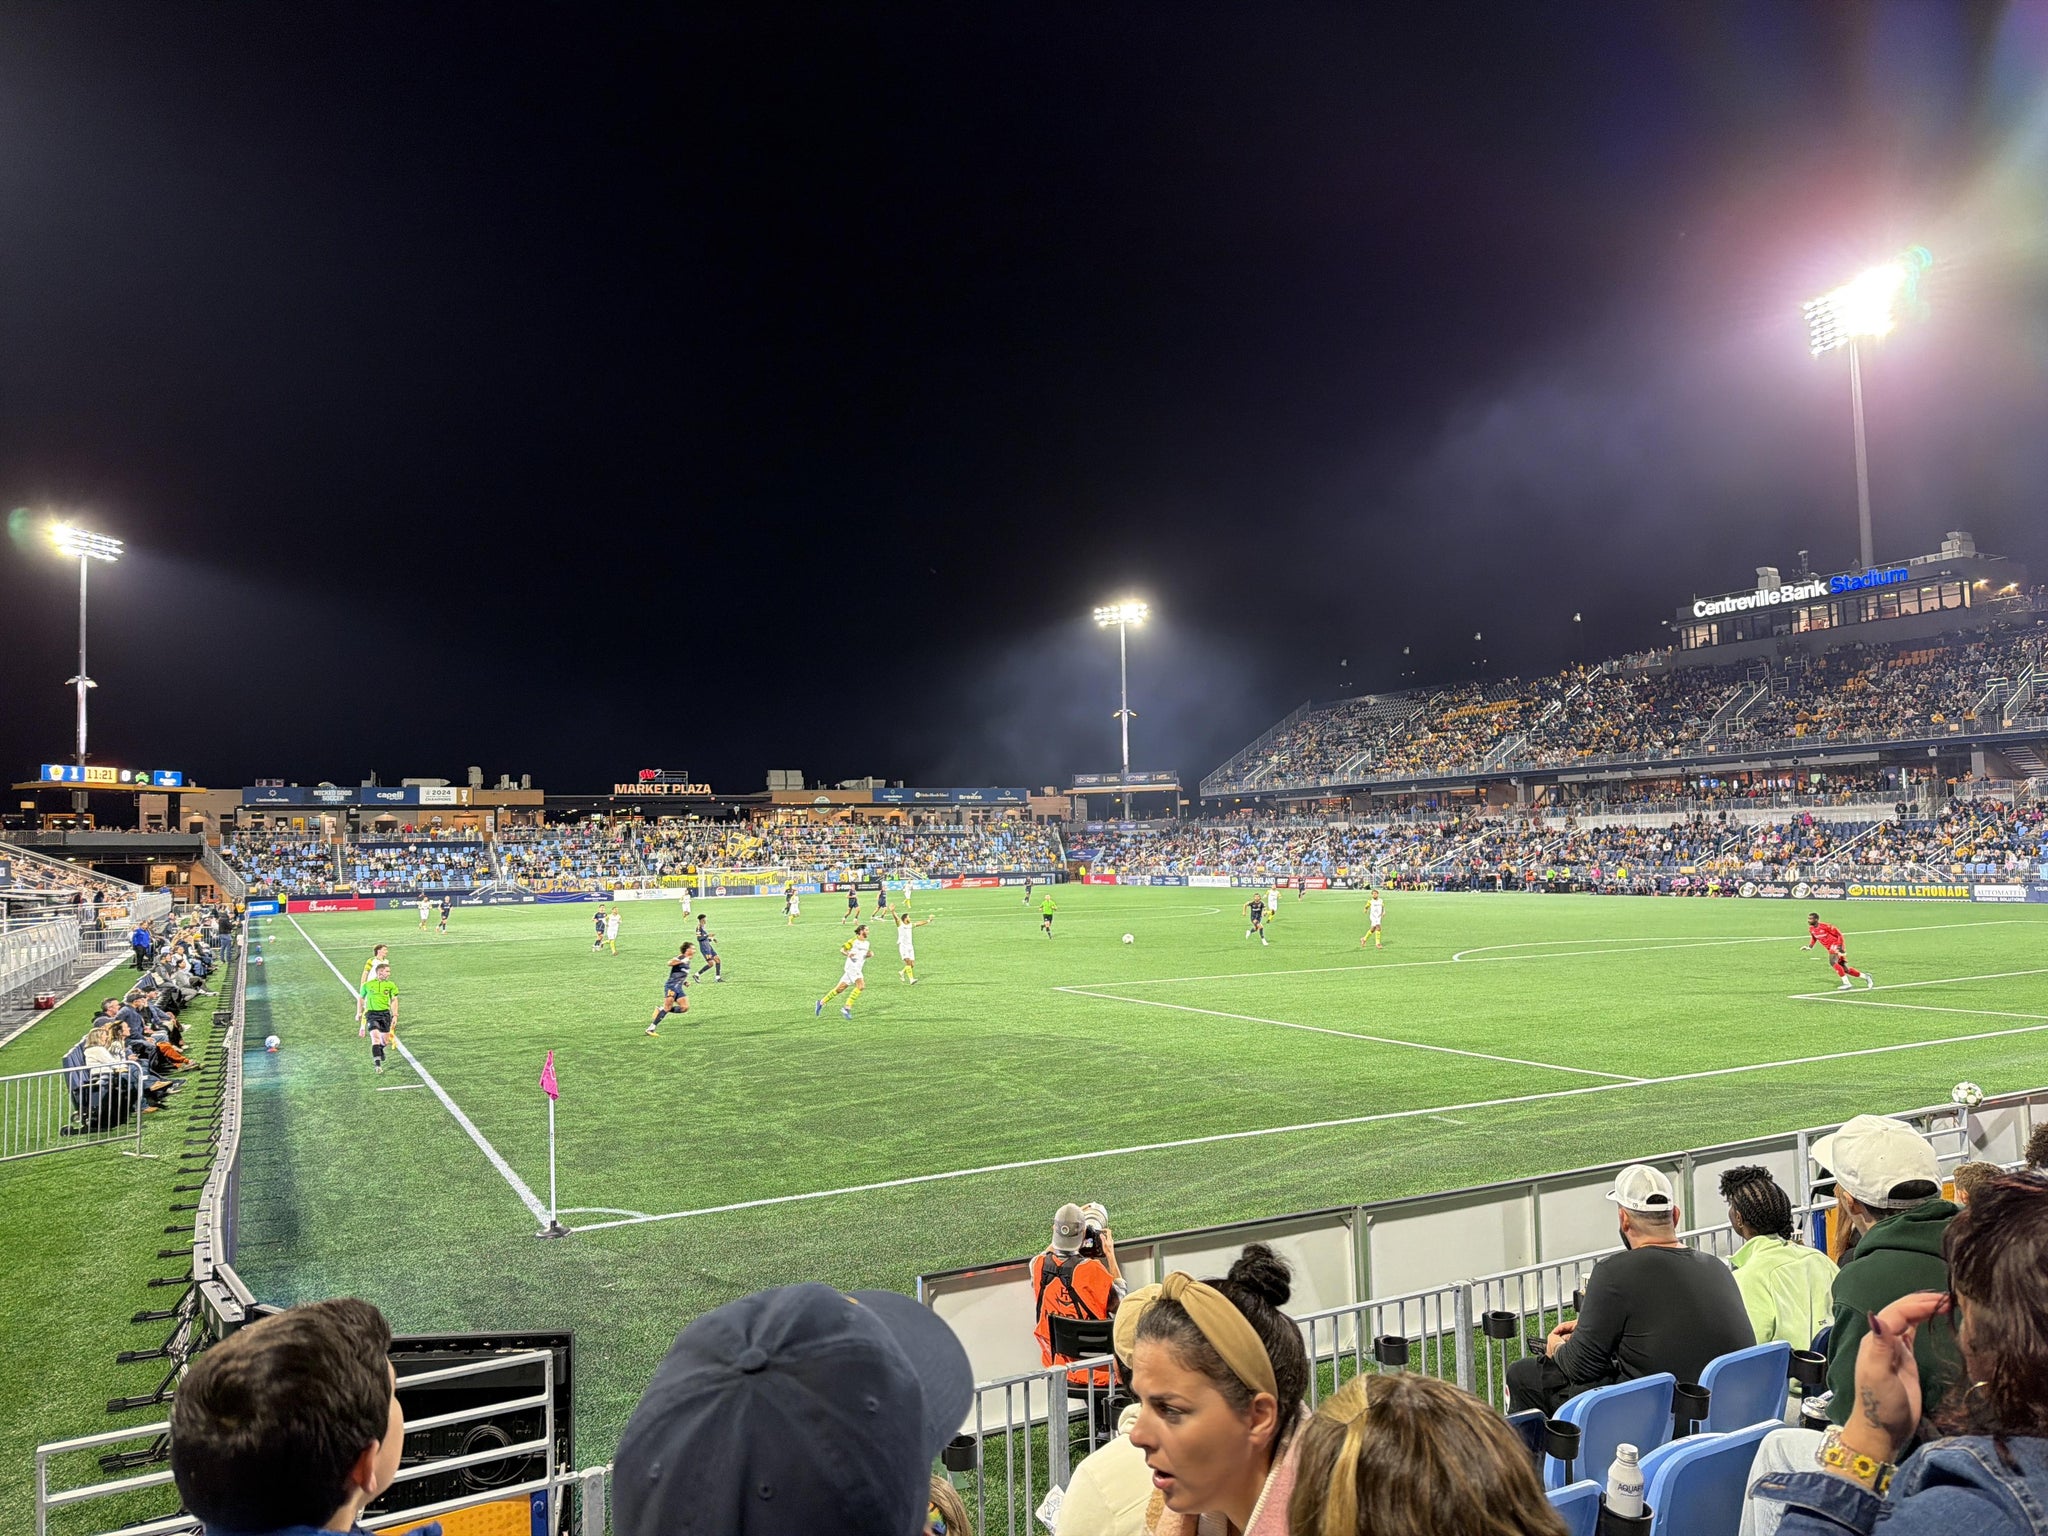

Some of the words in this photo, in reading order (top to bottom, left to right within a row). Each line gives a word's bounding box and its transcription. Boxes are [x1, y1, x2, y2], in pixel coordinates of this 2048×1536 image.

[1829, 567, 1908, 594] Stadium
[87, 768, 113, 780] 11:21
[614, 784, 669, 794] MARKET
[672, 784, 712, 794] PLAZA
[1863, 885, 1906, 897] FROZEN
[1908, 885, 1970, 897] LEMONADE
